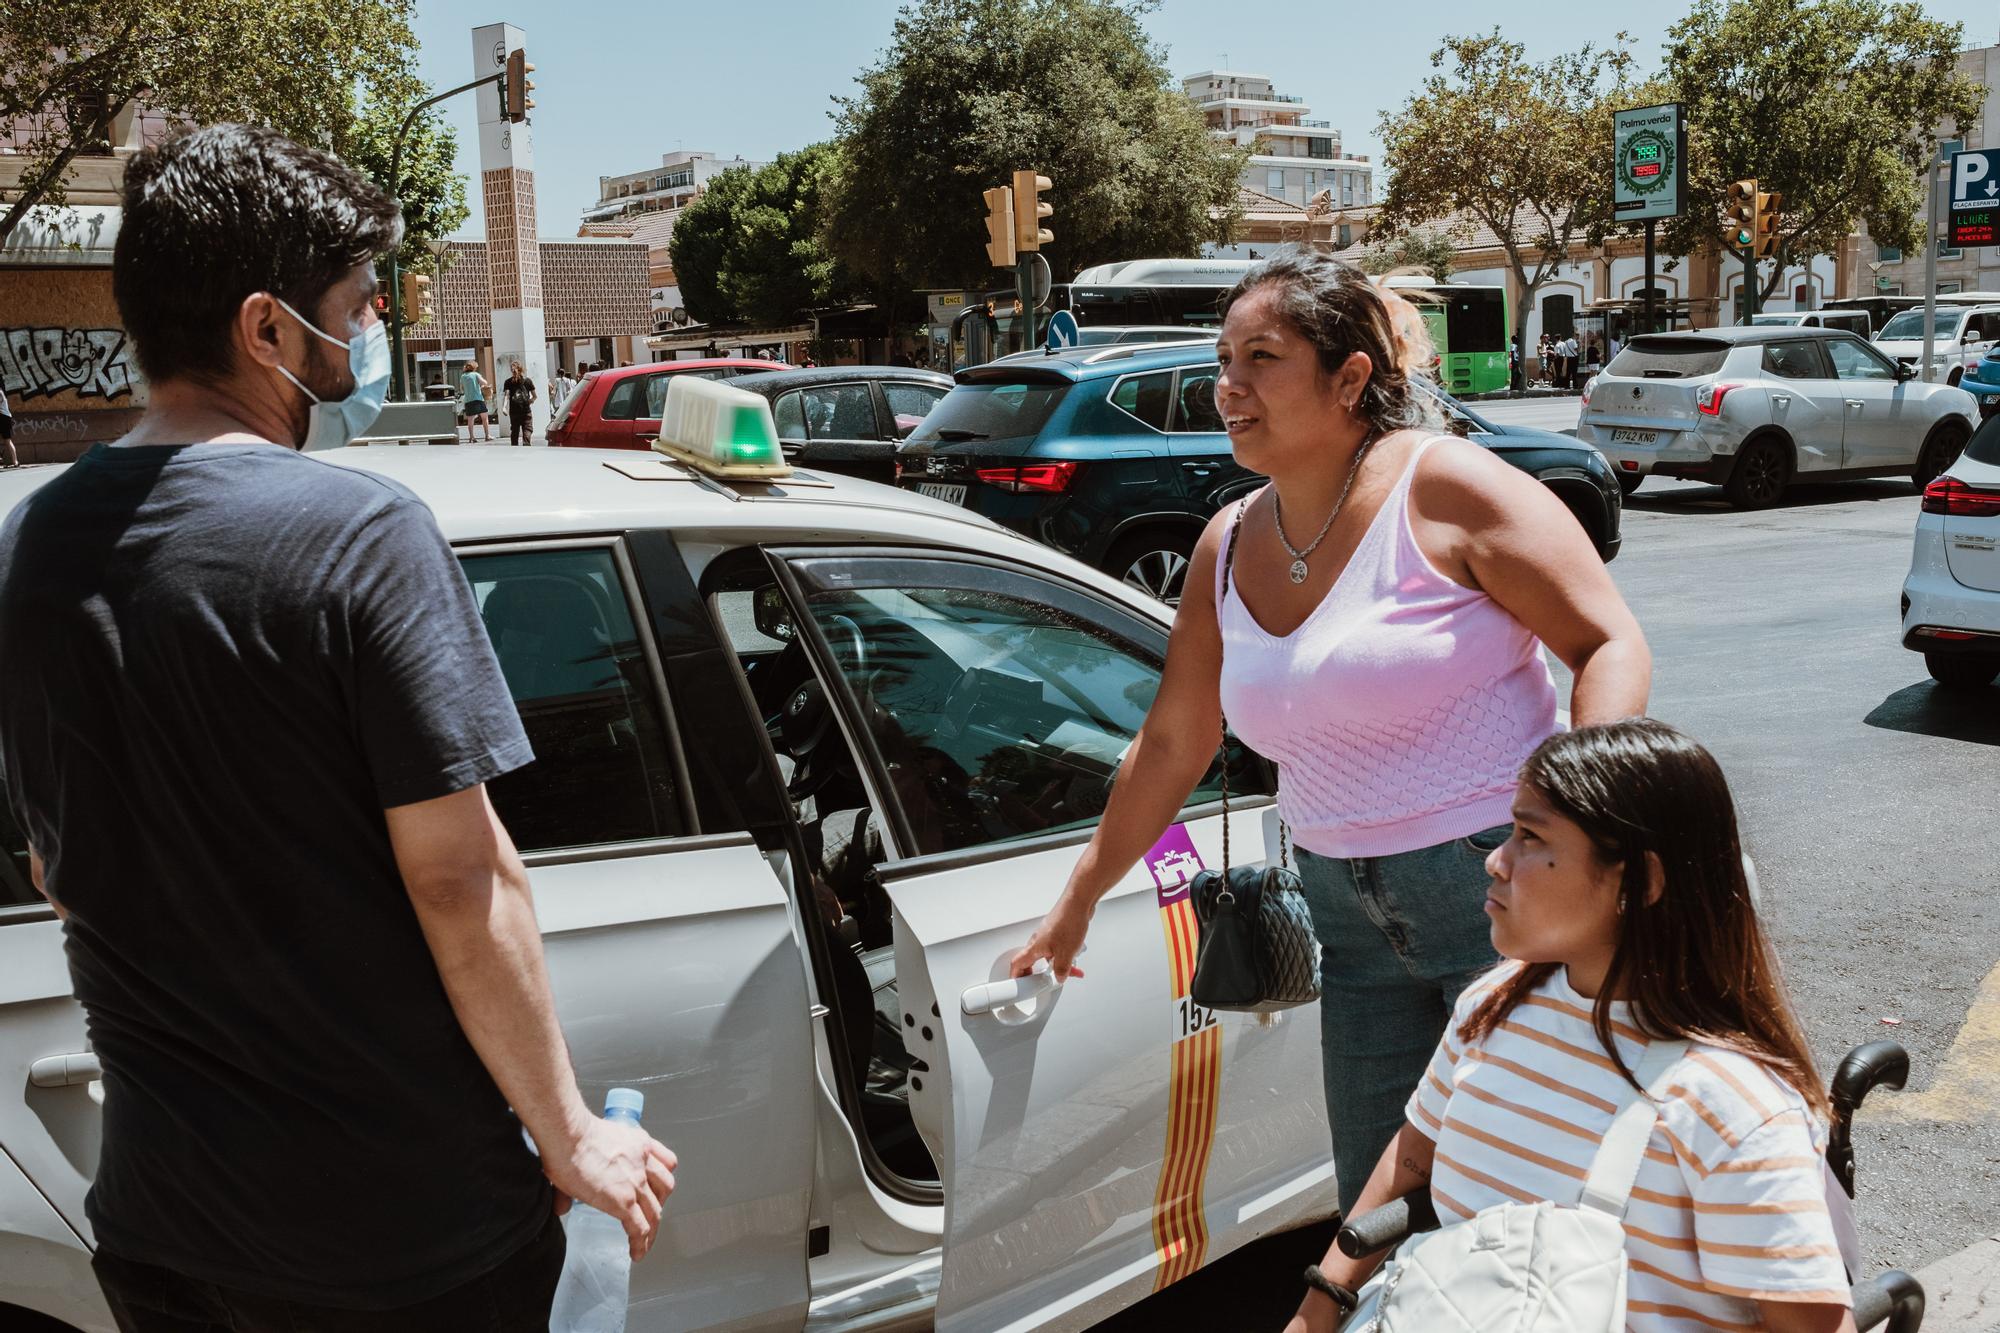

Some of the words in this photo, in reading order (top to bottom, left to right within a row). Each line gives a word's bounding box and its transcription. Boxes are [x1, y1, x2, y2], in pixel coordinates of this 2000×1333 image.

[1620, 118, 1646, 129] Palma
[1647, 114, 1671, 126] verda
[1955, 153, 1989, 200] P
[1973, 199, 1998, 207] ESPANYA
[1957, 213, 1990, 225] LLIURE
[1616, 431, 1638, 441] 3742
[1639, 432, 1656, 442] KNG
